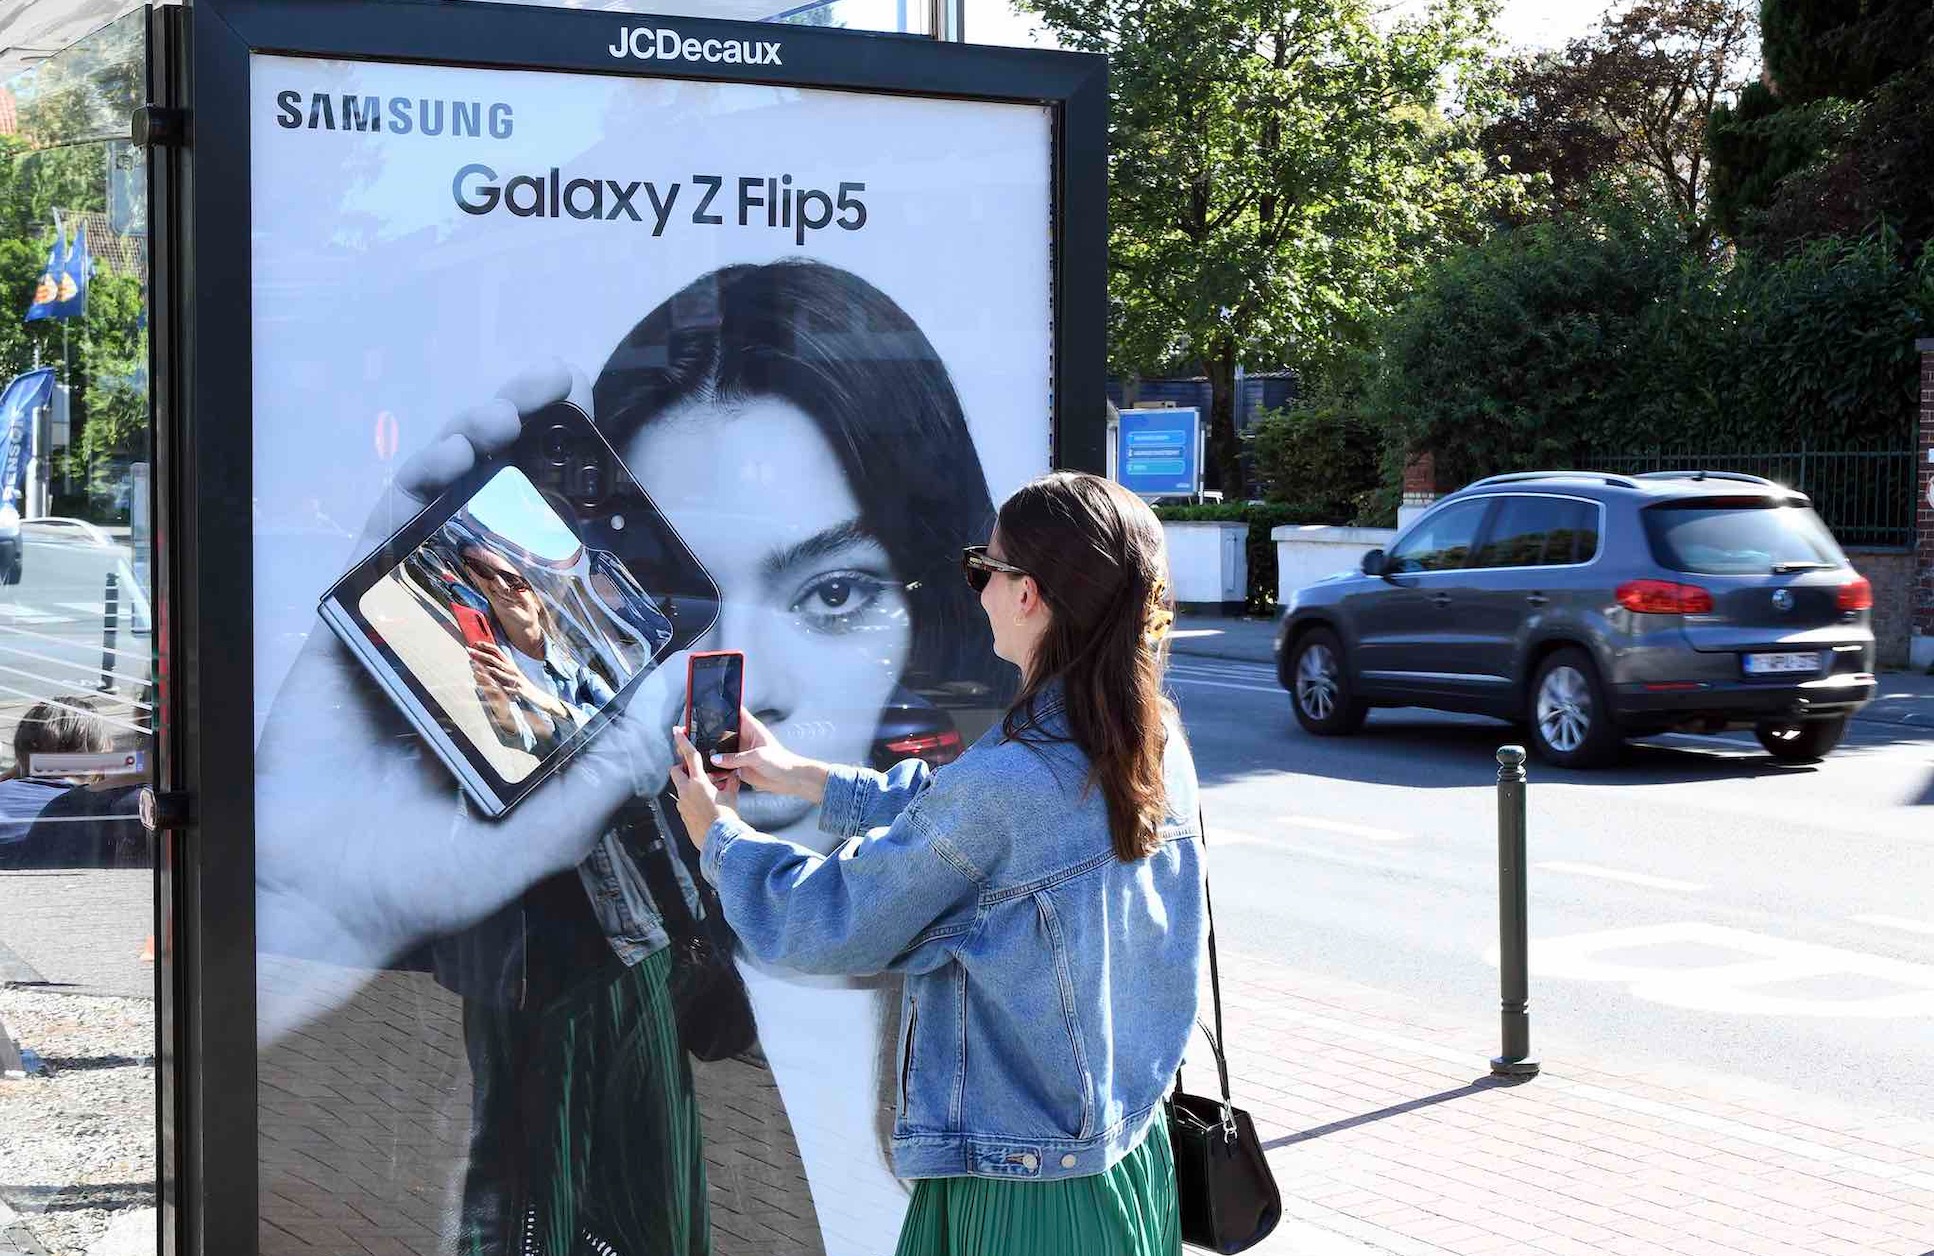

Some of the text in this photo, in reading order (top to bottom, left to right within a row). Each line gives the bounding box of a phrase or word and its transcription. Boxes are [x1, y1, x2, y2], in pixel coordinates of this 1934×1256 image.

[609, 26, 783, 65] JCDecaux
[276, 90, 514, 139] SAMSUNG
[452, 163, 868, 246] Galaxy Z Flip5
